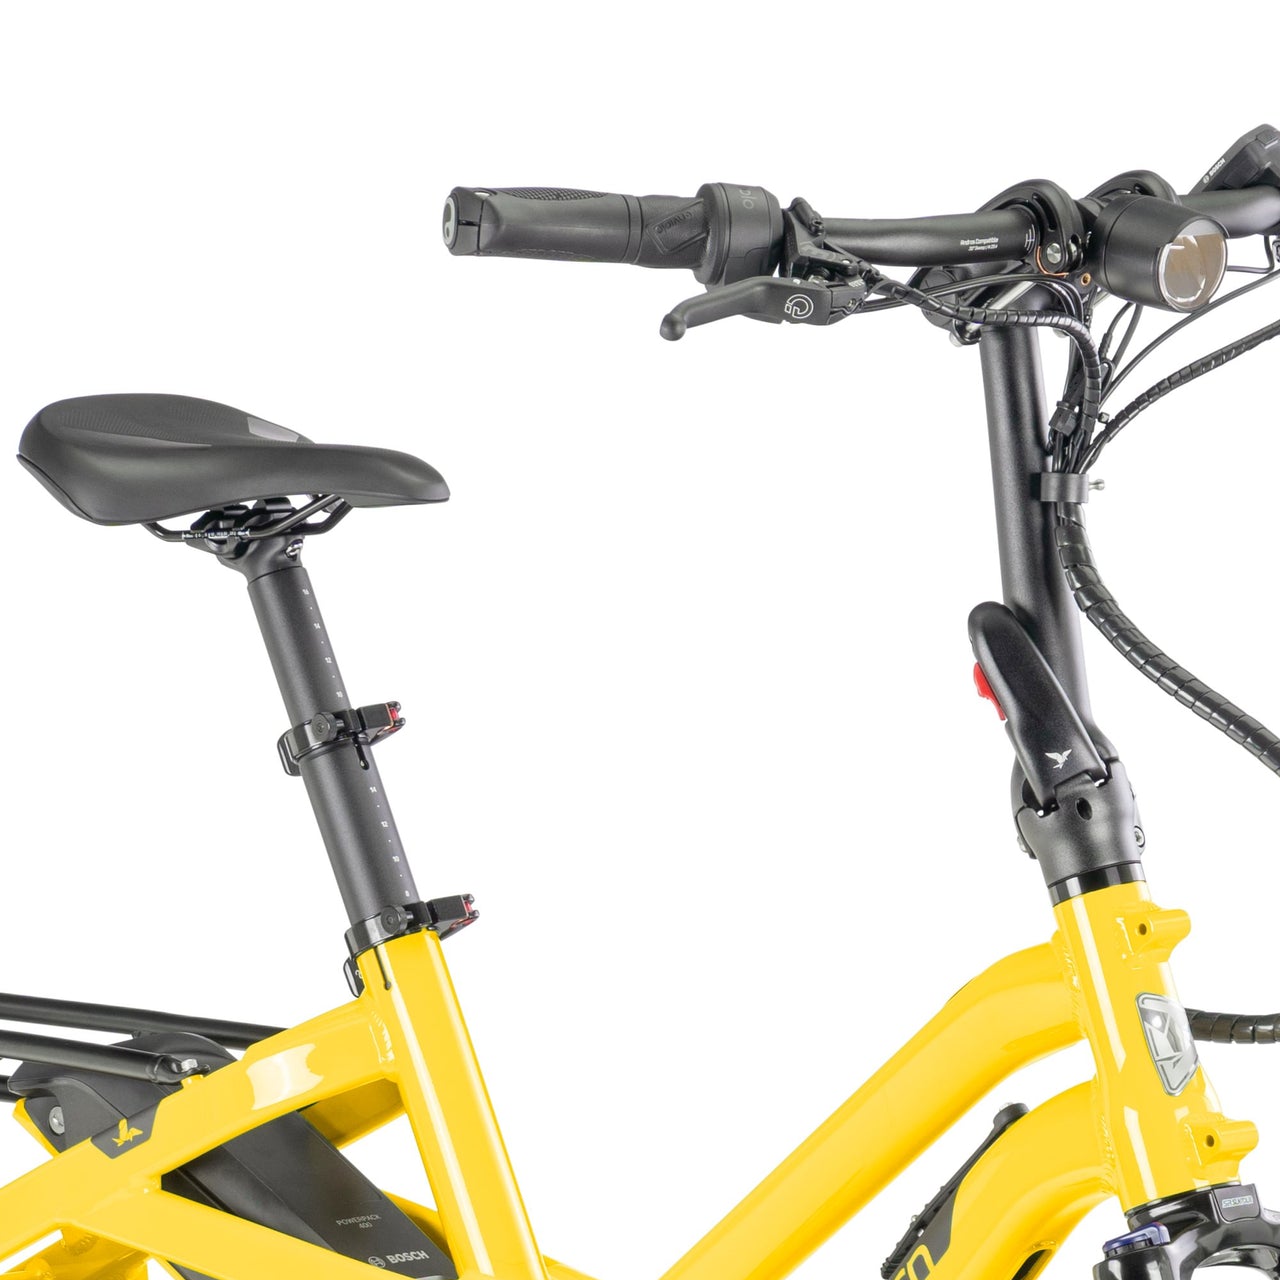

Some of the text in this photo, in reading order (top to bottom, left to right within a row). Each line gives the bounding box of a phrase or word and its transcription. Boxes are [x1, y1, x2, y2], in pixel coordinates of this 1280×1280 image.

[1209, 157, 1226, 177] BOSCH
[336, 1214, 382, 1226] POWERPACK
[386, 1250, 430, 1264] BOSCH
